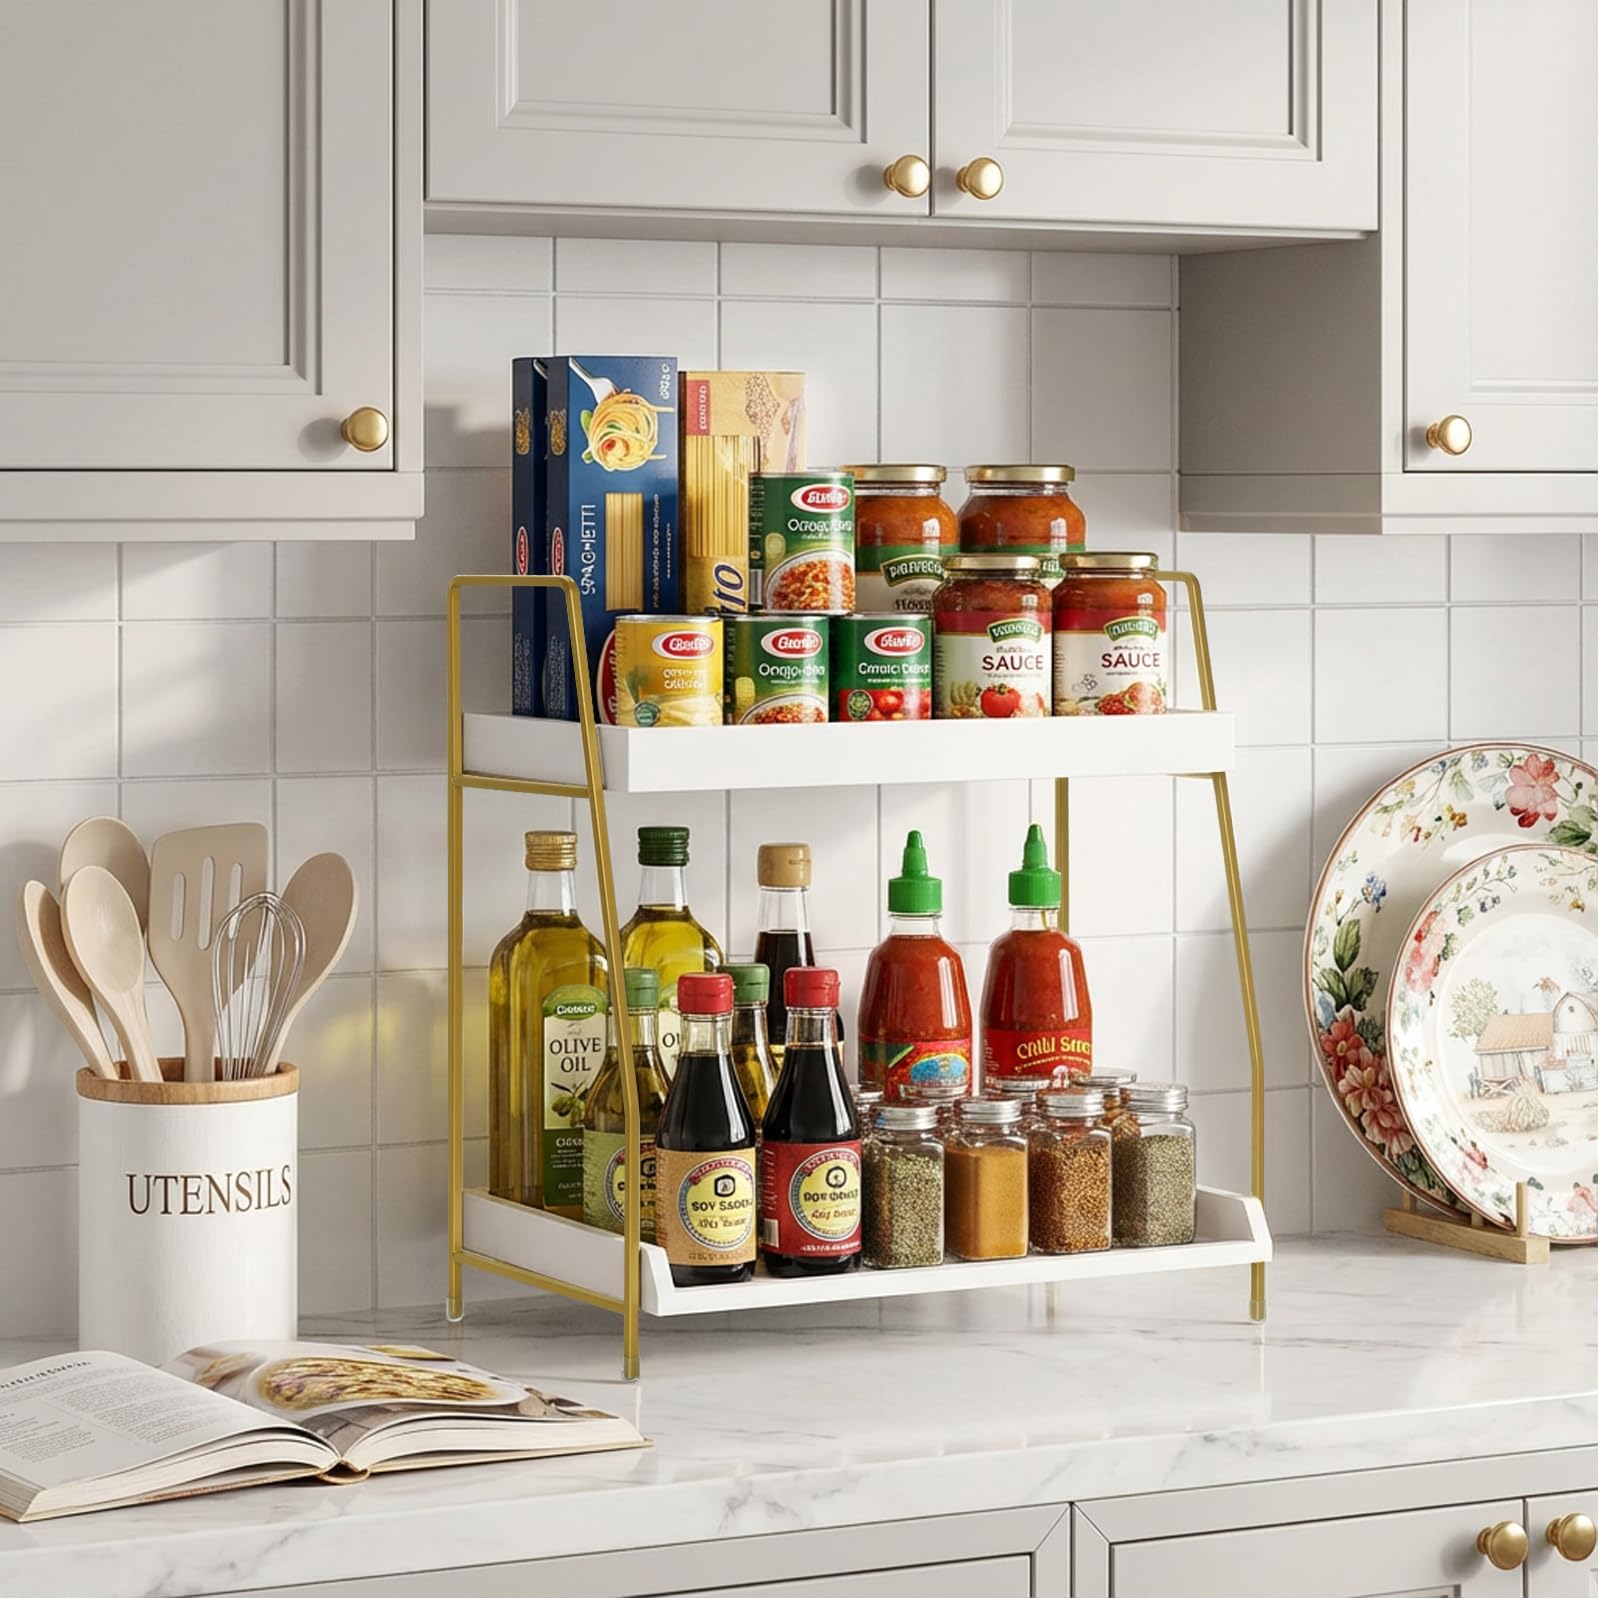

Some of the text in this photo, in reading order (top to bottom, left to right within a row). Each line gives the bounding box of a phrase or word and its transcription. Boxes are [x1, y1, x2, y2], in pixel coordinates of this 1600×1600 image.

[982, 655, 1044, 671] SAUCE
[1101, 652, 1160, 668] SAUCE
[549, 1037, 602, 1055] OLIVE
[560, 1056, 591, 1073] OIL
[126, 1164, 292, 1215] UTENSILS
